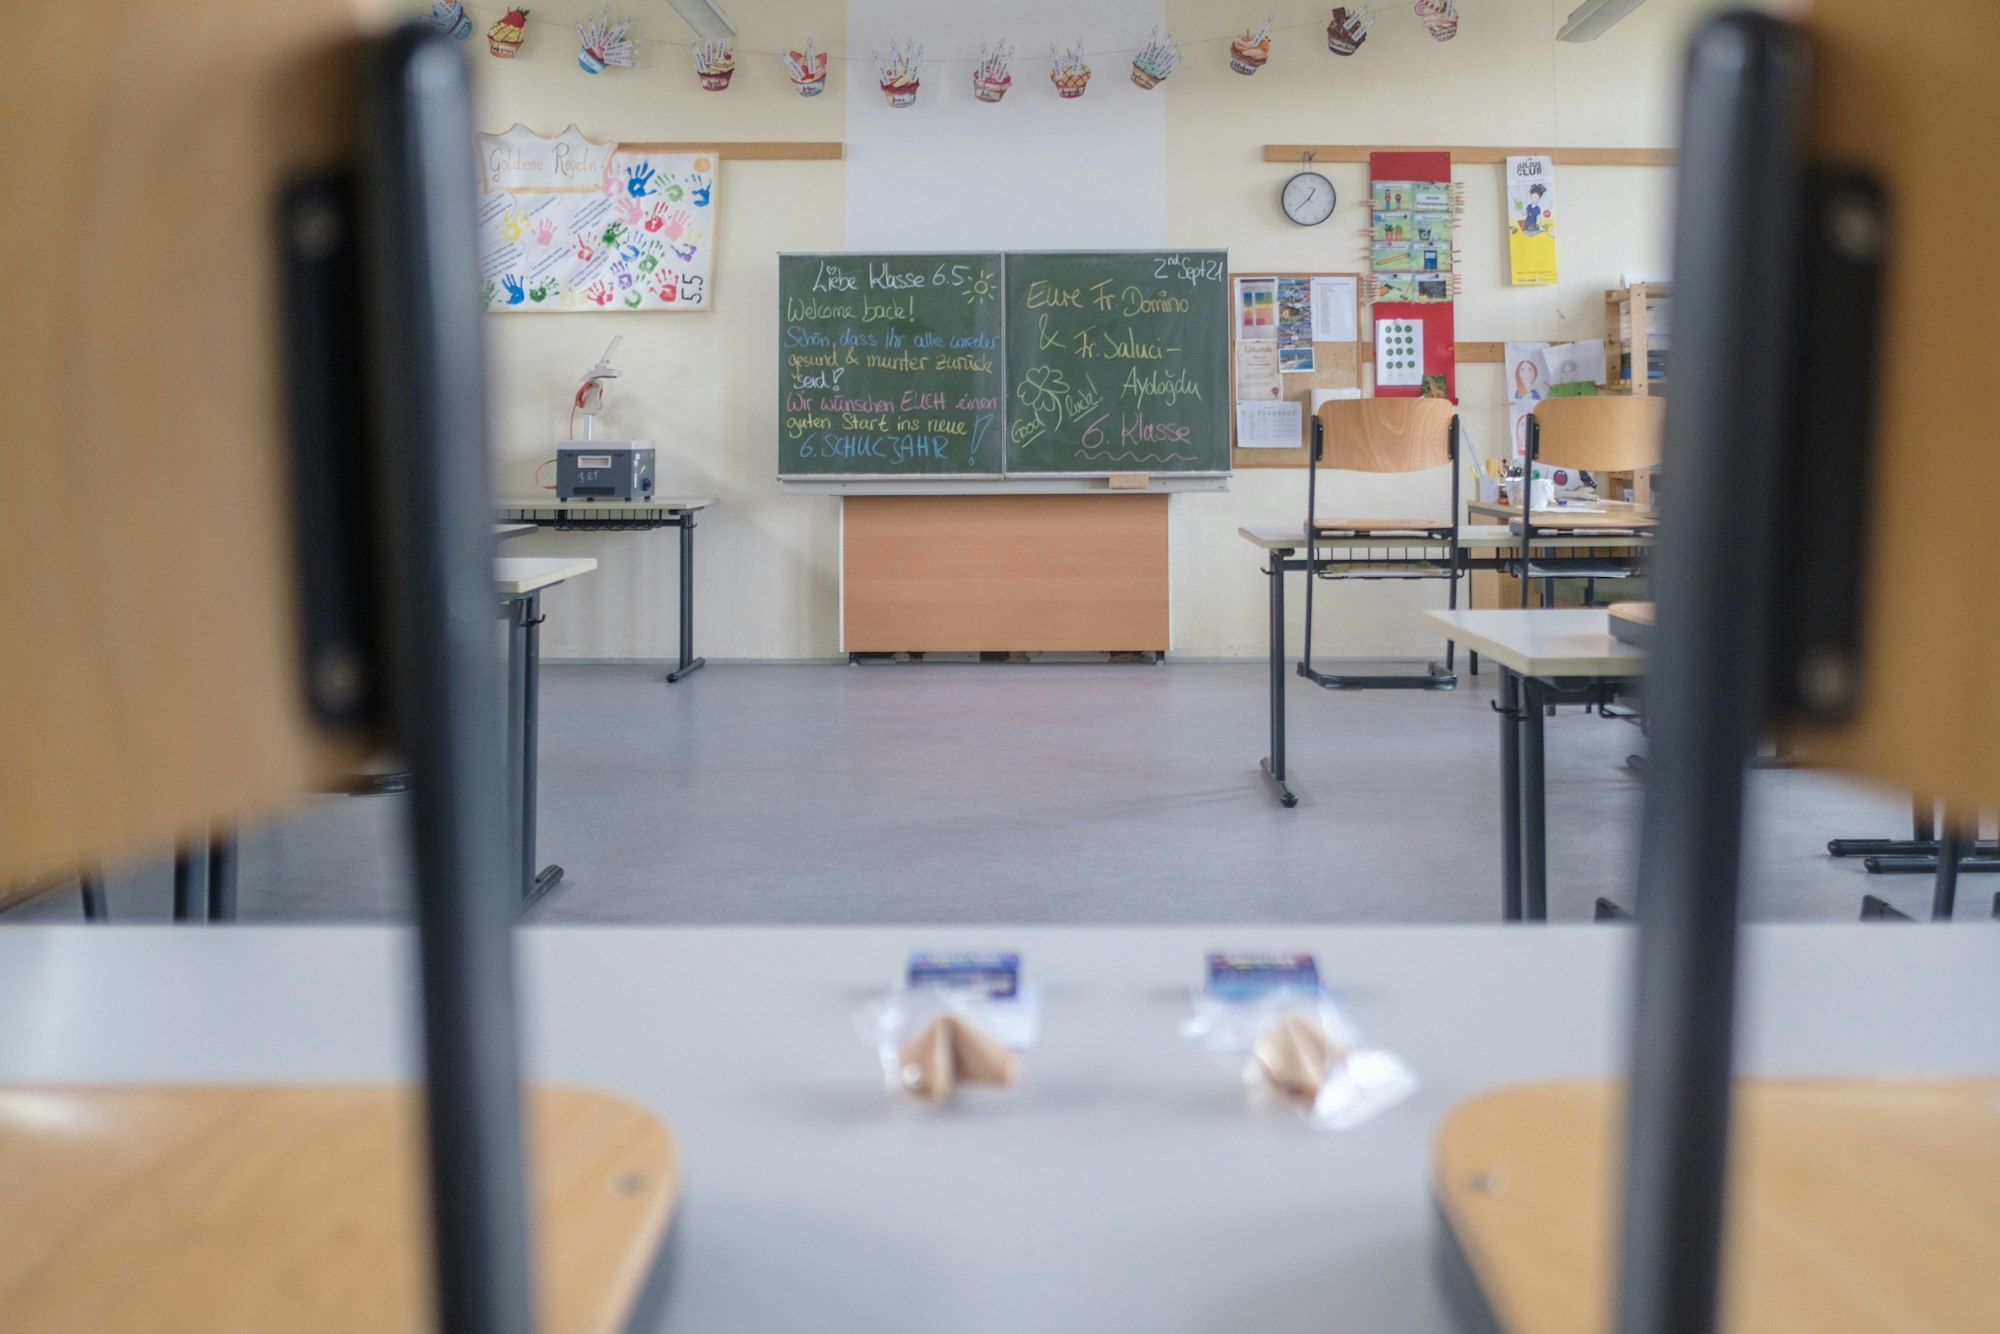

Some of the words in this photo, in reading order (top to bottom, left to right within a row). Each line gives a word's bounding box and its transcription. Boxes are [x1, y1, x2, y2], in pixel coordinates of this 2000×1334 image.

[490, 147, 544, 182] Goldene
[552, 143, 597, 178] Regeln
[1516, 167, 1543, 176] CLUB
[812, 260, 859, 292] Liebe
[869, 262, 926, 290] Klasse
[932, 263, 970, 286] 6.5
[787, 296, 857, 322] Welcome
[861, 294, 916, 323] back!
[1027, 279, 1084, 309] Eure
[1122, 285, 1189, 317] Domino
[839, 327, 878, 346] dass
[885, 327, 904, 349] Ihr
[913, 331, 944, 348] alle
[950, 331, 1000, 349] wieder
[1038, 313, 1066, 350] &
[1073, 325, 1100, 359] Fr.
[788, 350, 838, 377] gesund
[844, 347, 859, 365] &
[866, 350, 930, 371] munter
[935, 351, 993, 374] zurück
[786, 390, 811, 412] Wir
[820, 394, 895, 413] wünschen
[900, 390, 946, 411] EUCH
[955, 394, 998, 412] einen
[786, 413, 831, 438] guten
[842, 412, 890, 433] Start
[897, 416, 921, 431] ins
[927, 417, 968, 435] neue
[1011, 411, 1047, 444] Good
[1081, 414, 1110, 449] 6.
[1121, 411, 1192, 447] Klasse
[800, 432, 817, 458] 6.
